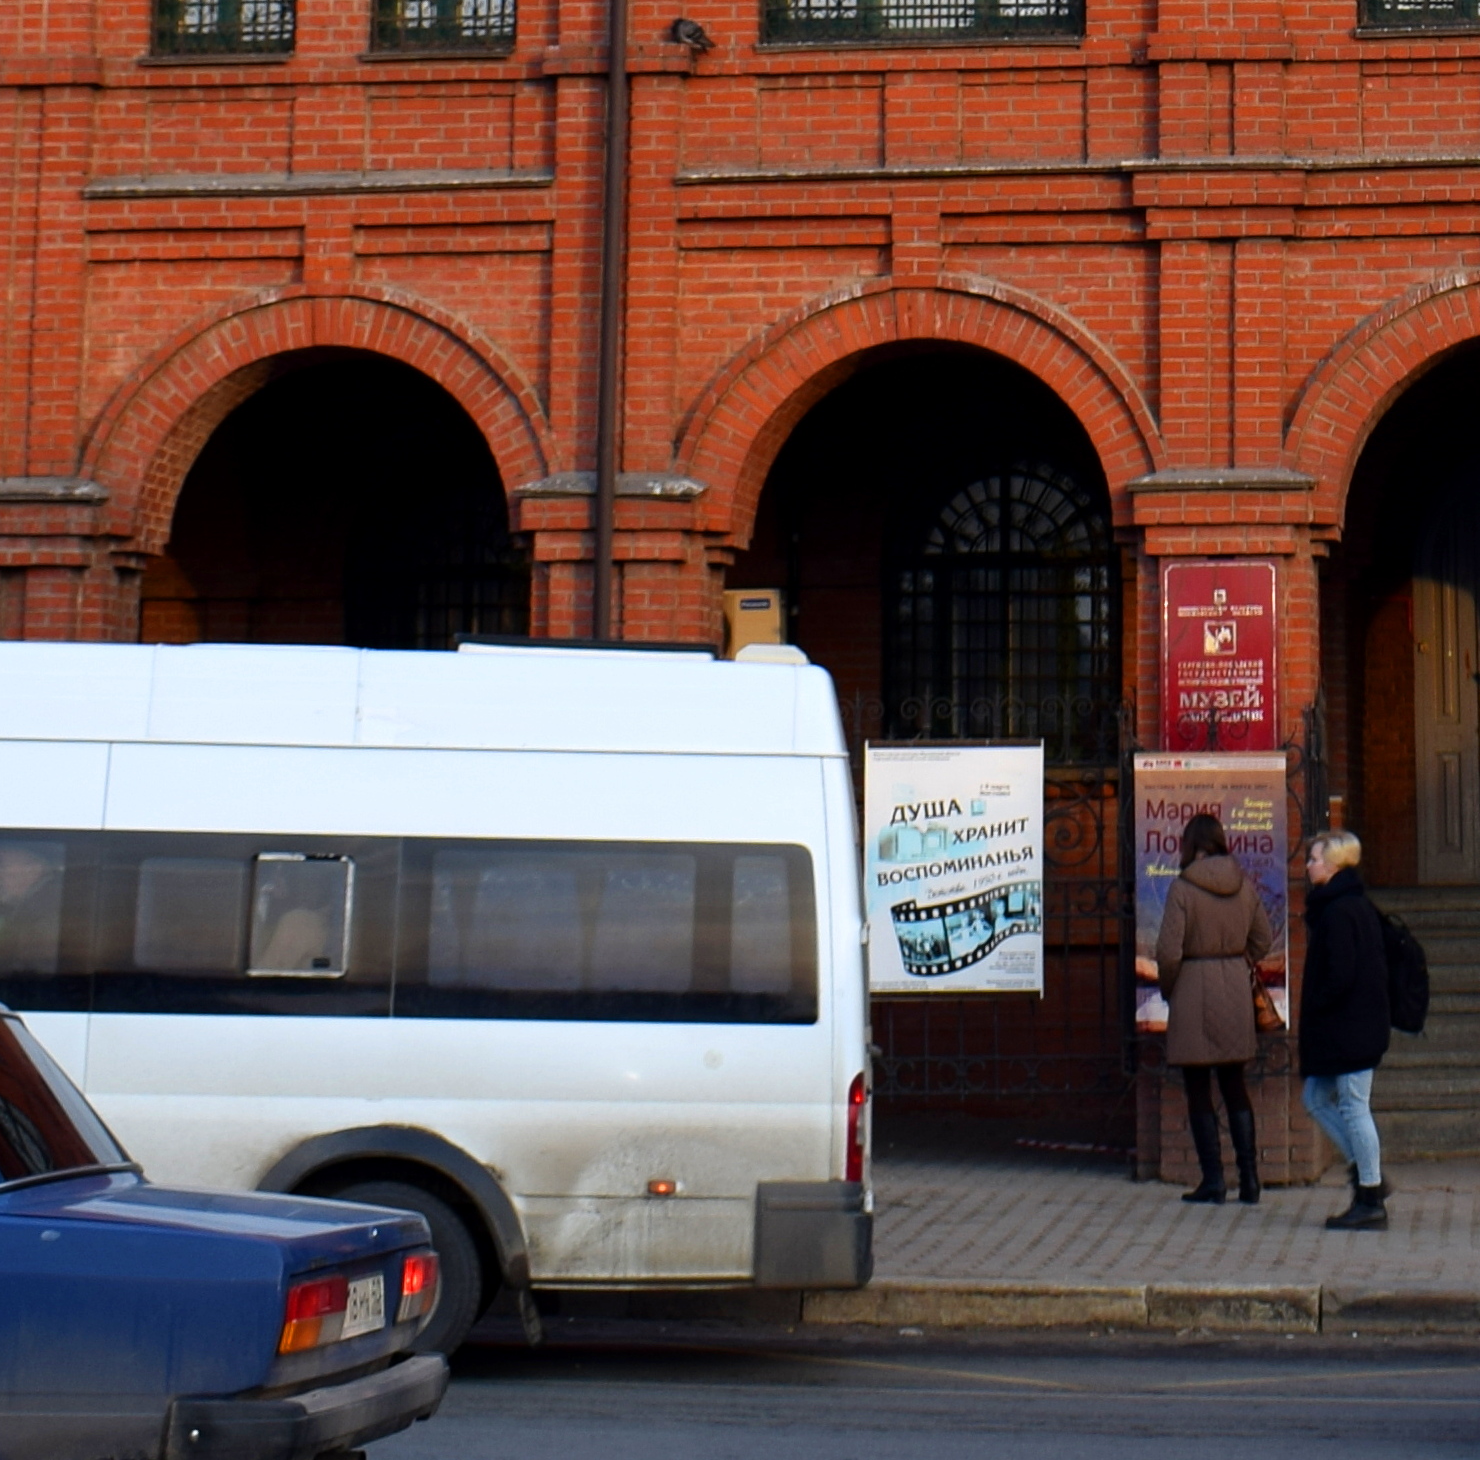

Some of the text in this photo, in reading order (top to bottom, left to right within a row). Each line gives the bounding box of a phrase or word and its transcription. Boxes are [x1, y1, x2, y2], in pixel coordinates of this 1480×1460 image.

[889, 797, 963, 827] ДУША
[1145, 798, 1222, 826] Мария
[952, 816, 1030, 845] ХРАНИТ
[1144, 829, 1274, 855] Лоина
[876, 844, 1035, 887] ВОСПОМИНАНЬЯ
